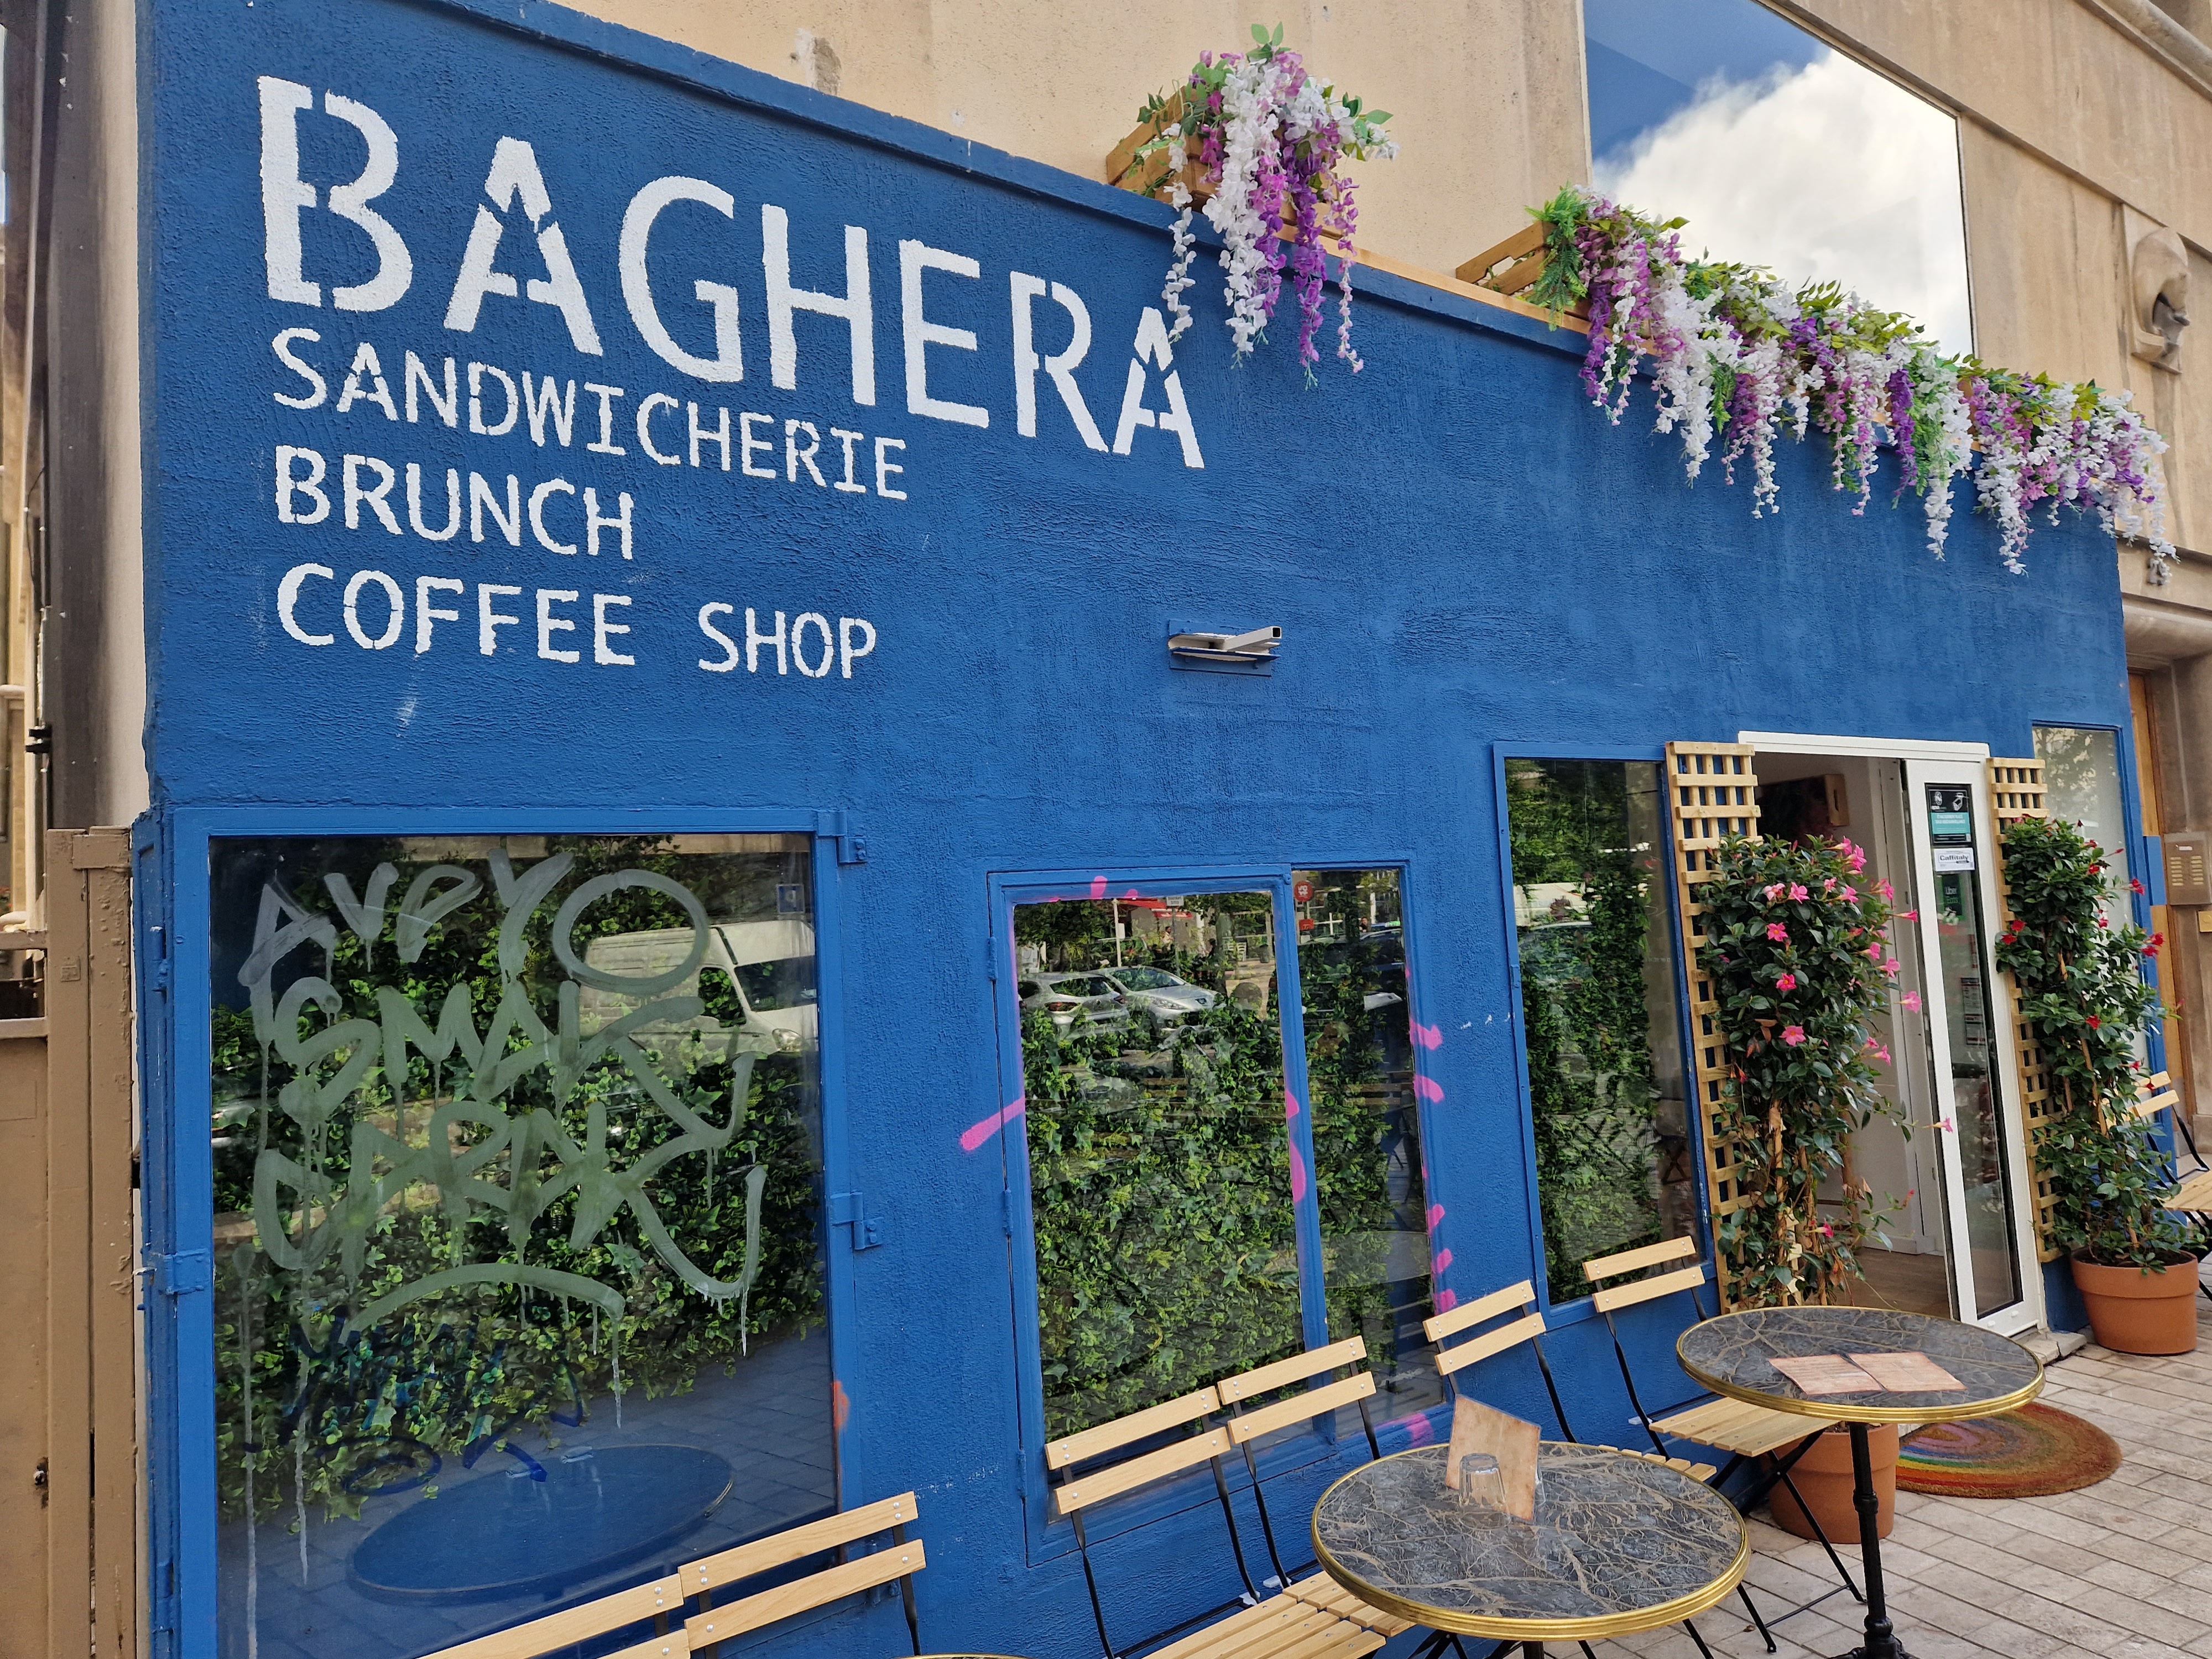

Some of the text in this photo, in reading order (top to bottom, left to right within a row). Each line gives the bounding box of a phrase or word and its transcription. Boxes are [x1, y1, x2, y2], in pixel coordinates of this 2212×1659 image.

[256, 75, 1205, 469] BAGHERA
[272, 327, 907, 502] SANDWICHERIE
[275, 445, 635, 560] BRUNCH
[276, 562, 877, 679] COFFEE SHOP
